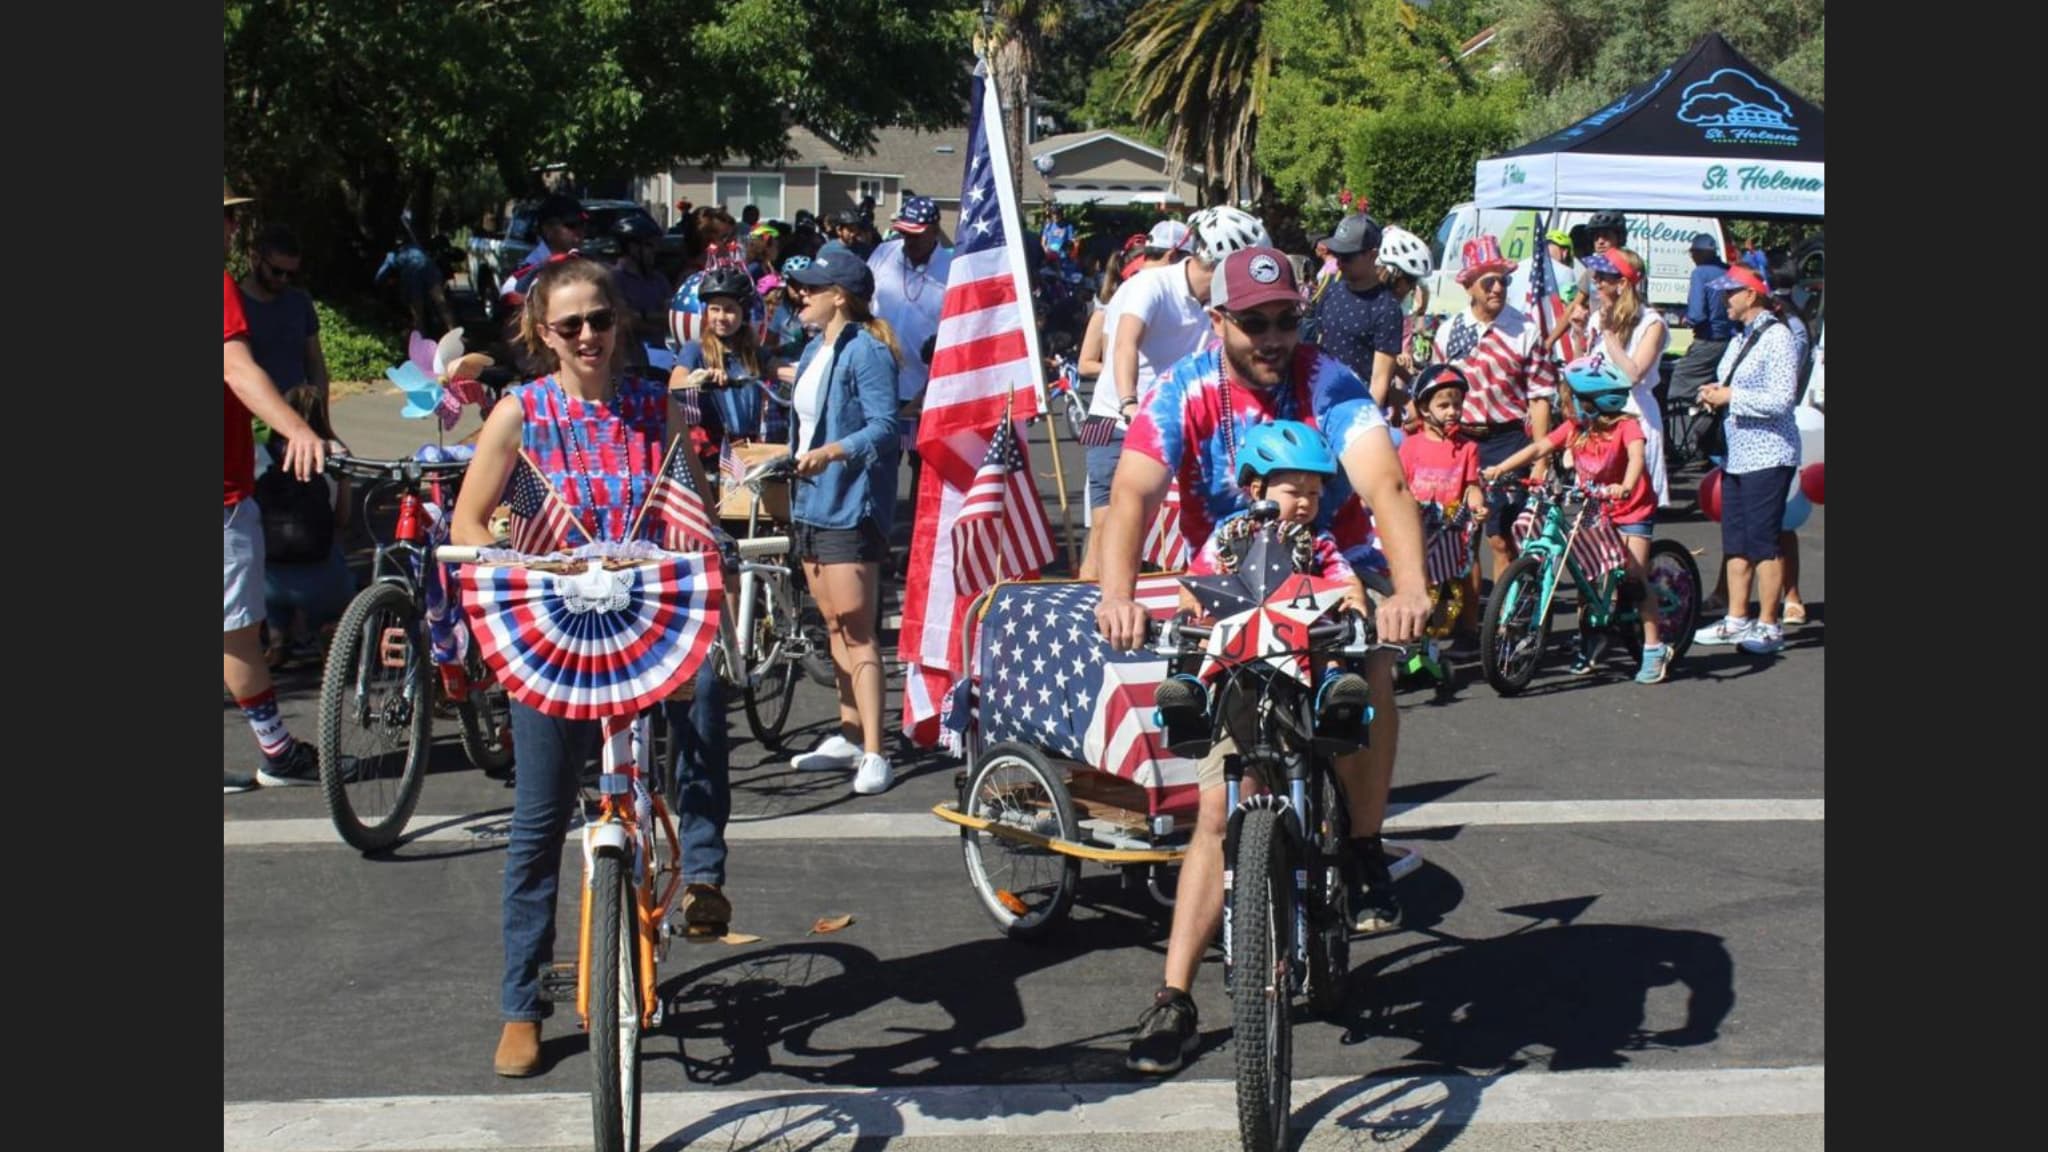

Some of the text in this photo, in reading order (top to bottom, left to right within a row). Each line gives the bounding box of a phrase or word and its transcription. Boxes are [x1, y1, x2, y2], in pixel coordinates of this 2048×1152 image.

[1730, 128, 1799, 142] Helena
[1702, 164, 1824, 192] St. Helena
